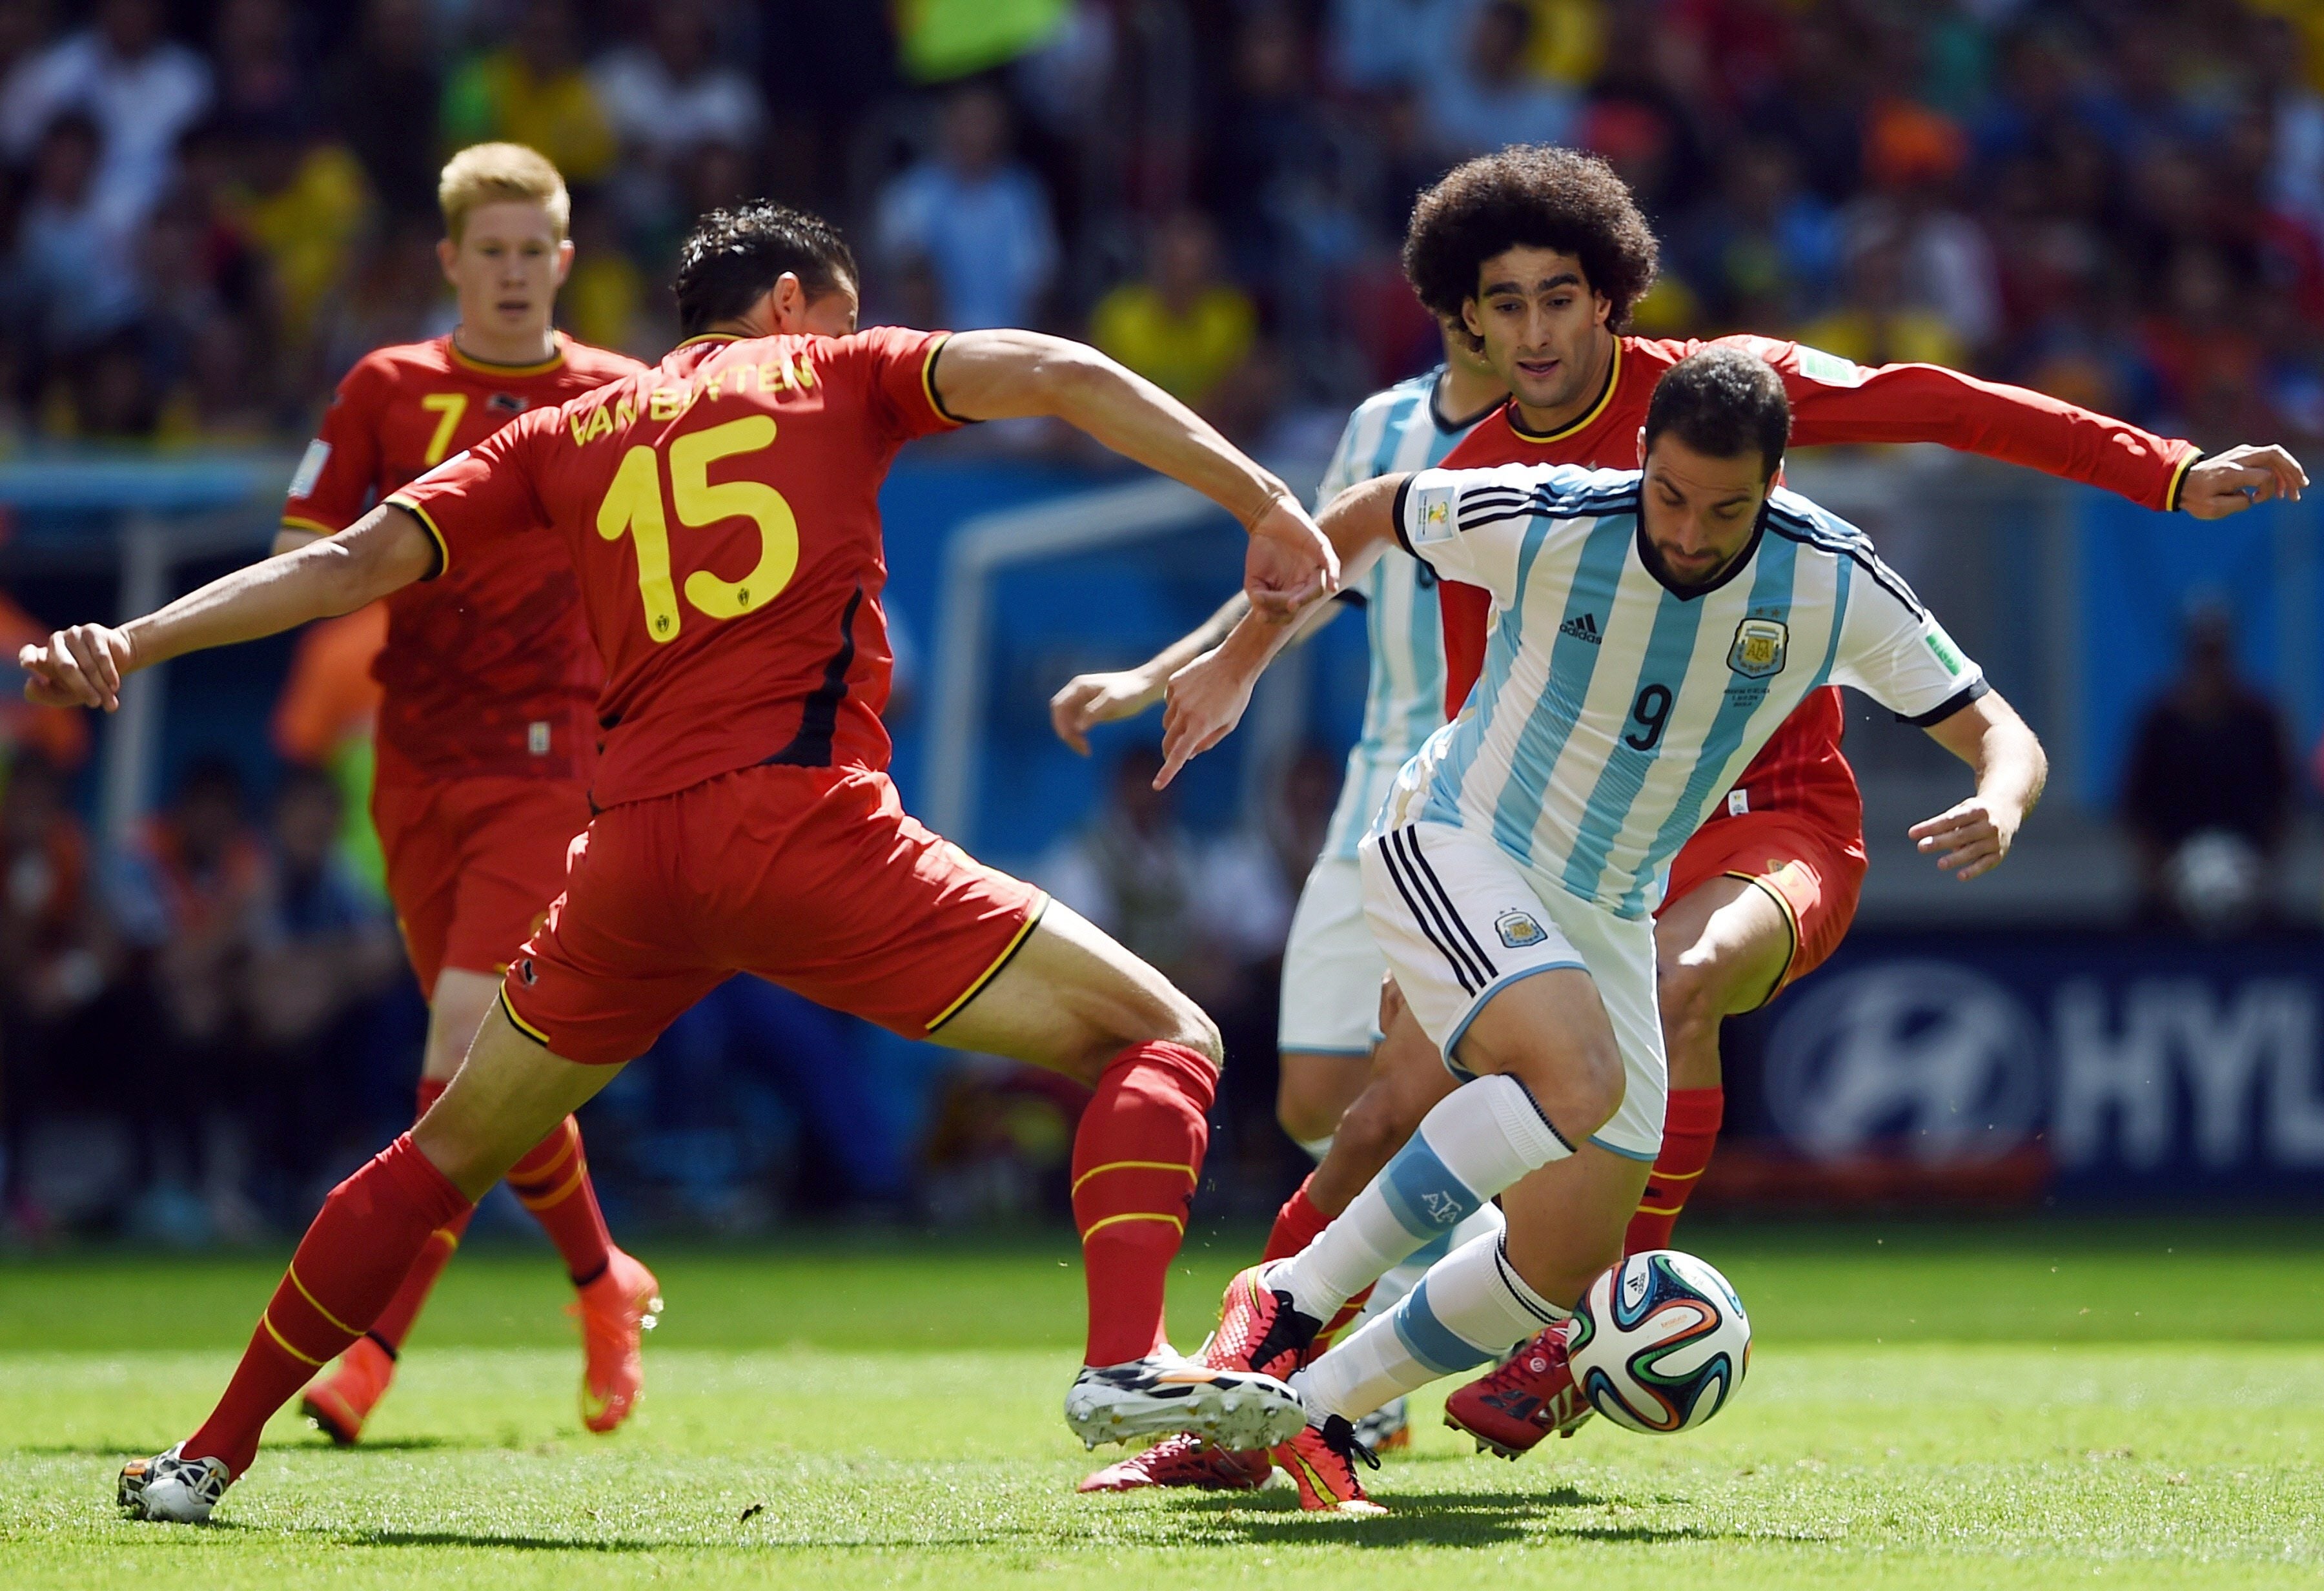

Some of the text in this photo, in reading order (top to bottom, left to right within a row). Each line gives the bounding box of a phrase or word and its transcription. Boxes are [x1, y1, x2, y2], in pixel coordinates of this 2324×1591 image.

[422, 393, 468, 466] 7
[570, 393, 639, 447] VAN
[596, 414, 799, 643] 15
[1559, 624, 1602, 644] adidas
[1626, 684, 1672, 751] 9
